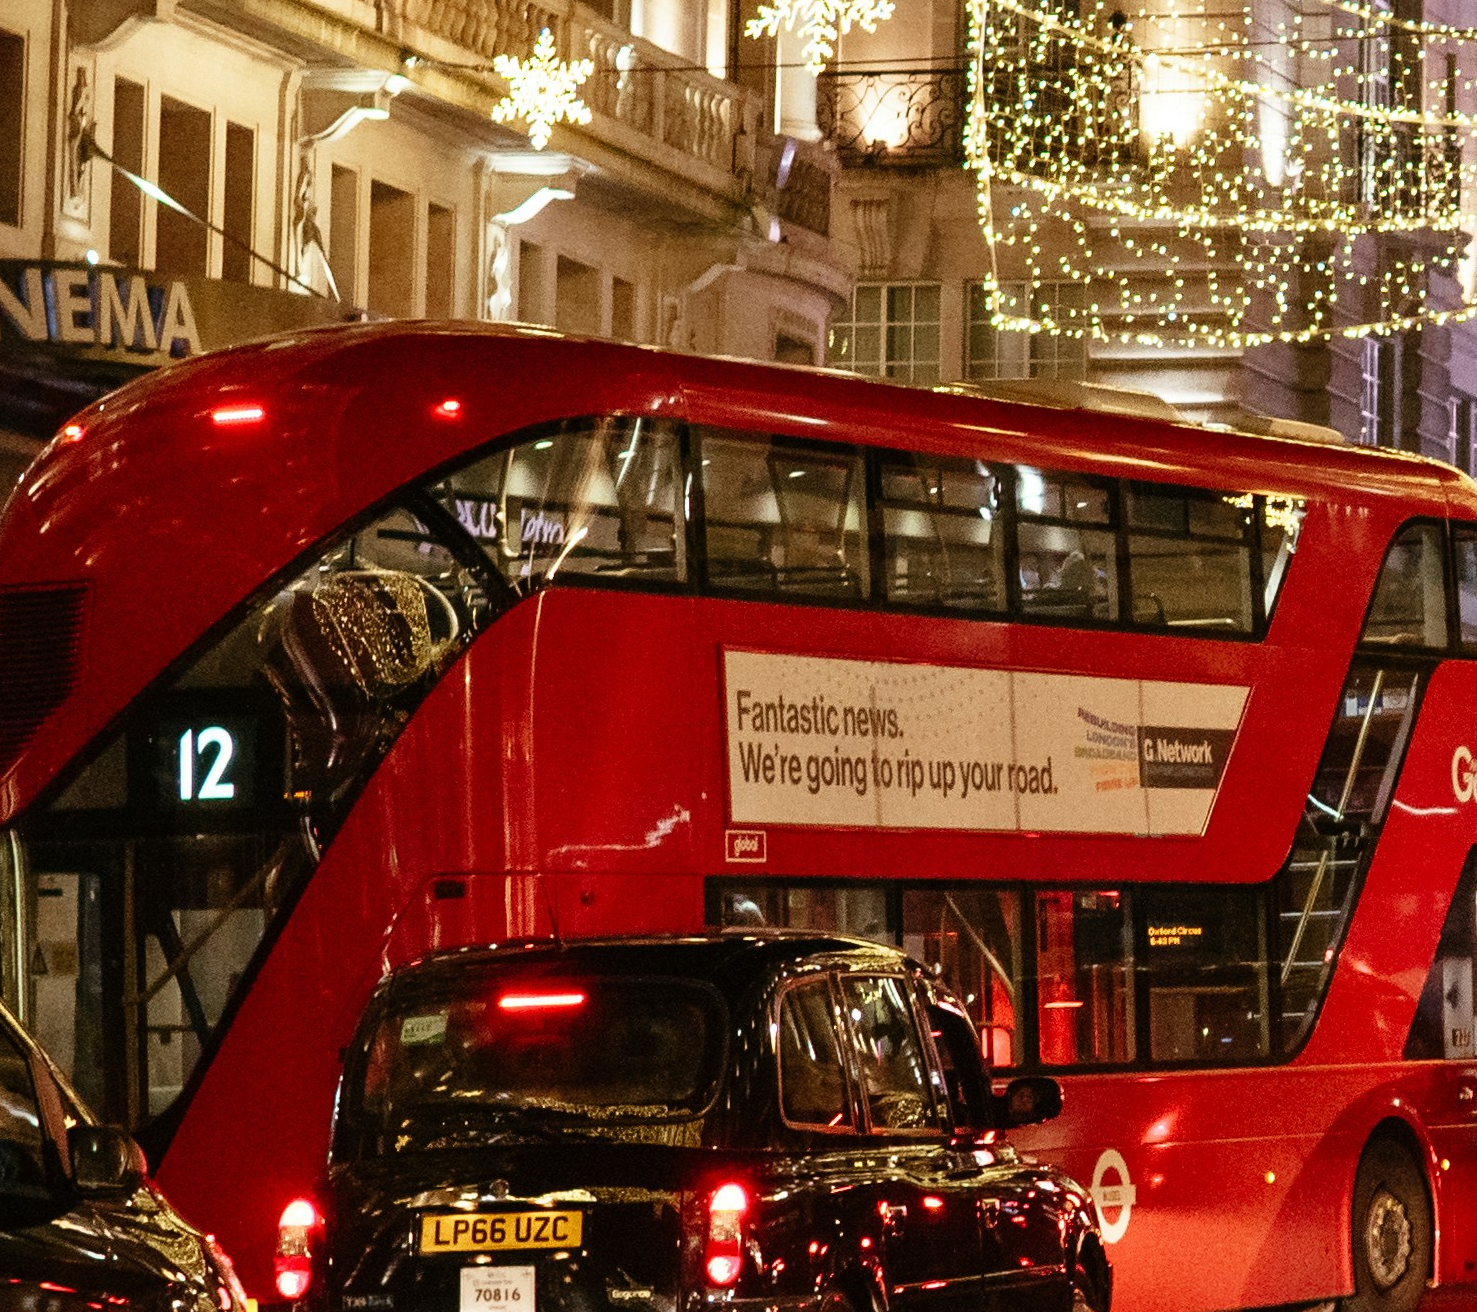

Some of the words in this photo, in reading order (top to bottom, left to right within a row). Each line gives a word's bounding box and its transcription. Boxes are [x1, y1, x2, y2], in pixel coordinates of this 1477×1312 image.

[736, 690, 840, 737] Fantastic
[844, 707, 905, 738] news.
[180, 726, 234, 800] 12
[738, 742, 803, 785] We're
[806, 746, 868, 796] going
[872, 753, 894, 788] to
[898, 749, 924, 798] rip
[930, 760, 957, 799] up
[961, 760, 1005, 799] your
[1008, 756, 1060, 795] road.
[1157, 739, 1213, 764] Network
[434, 1219, 506, 1246] LP66
[514, 1216, 569, 1242] UZC
[475, 1287, 521, 1302] 70816
